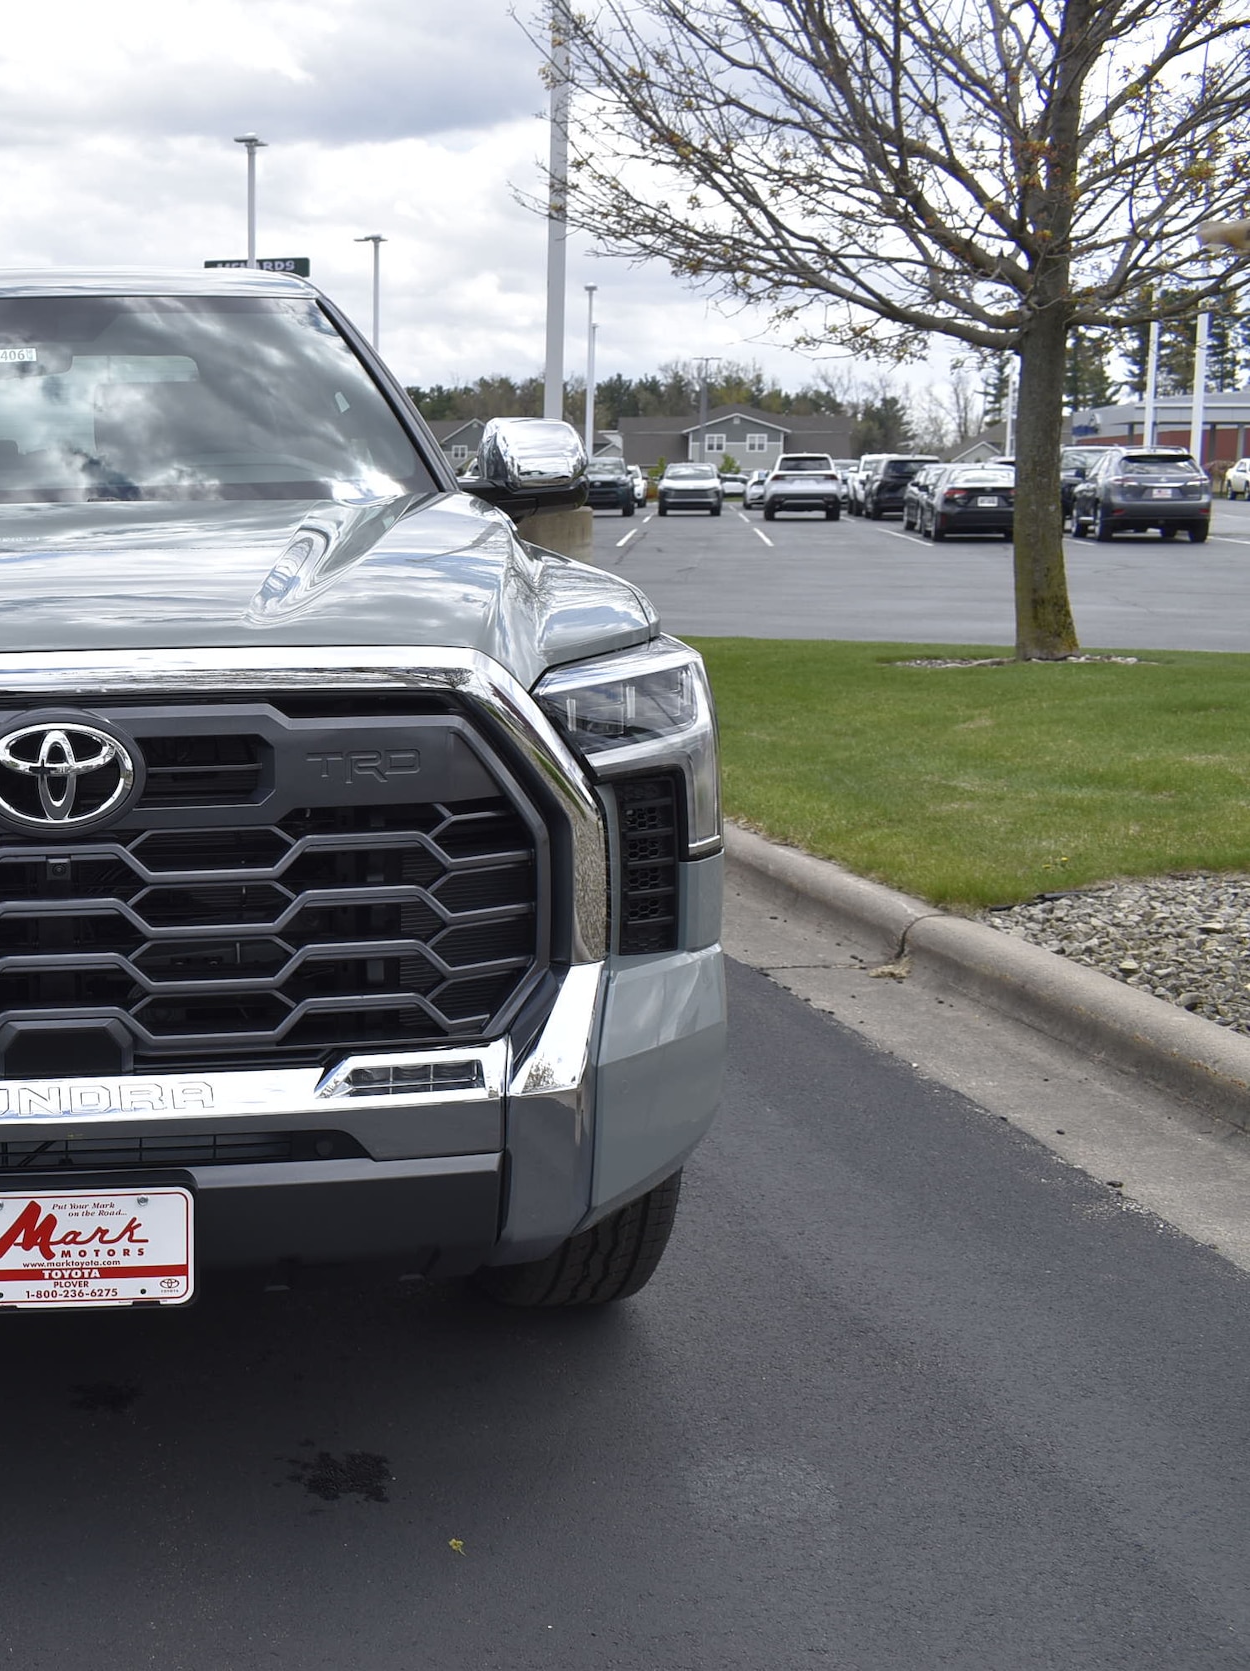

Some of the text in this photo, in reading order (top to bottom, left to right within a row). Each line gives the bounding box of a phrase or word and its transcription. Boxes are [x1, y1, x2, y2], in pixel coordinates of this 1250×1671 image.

[306, 749, 421, 785] TRD
[61, 1248, 145, 1258] MOTORS
[22, 1260, 121, 1268] www.marktoyota.com
[42, 1269, 101, 1279] TOYOTA
[26, 1288, 118, 1299] 1-800-236-6275
